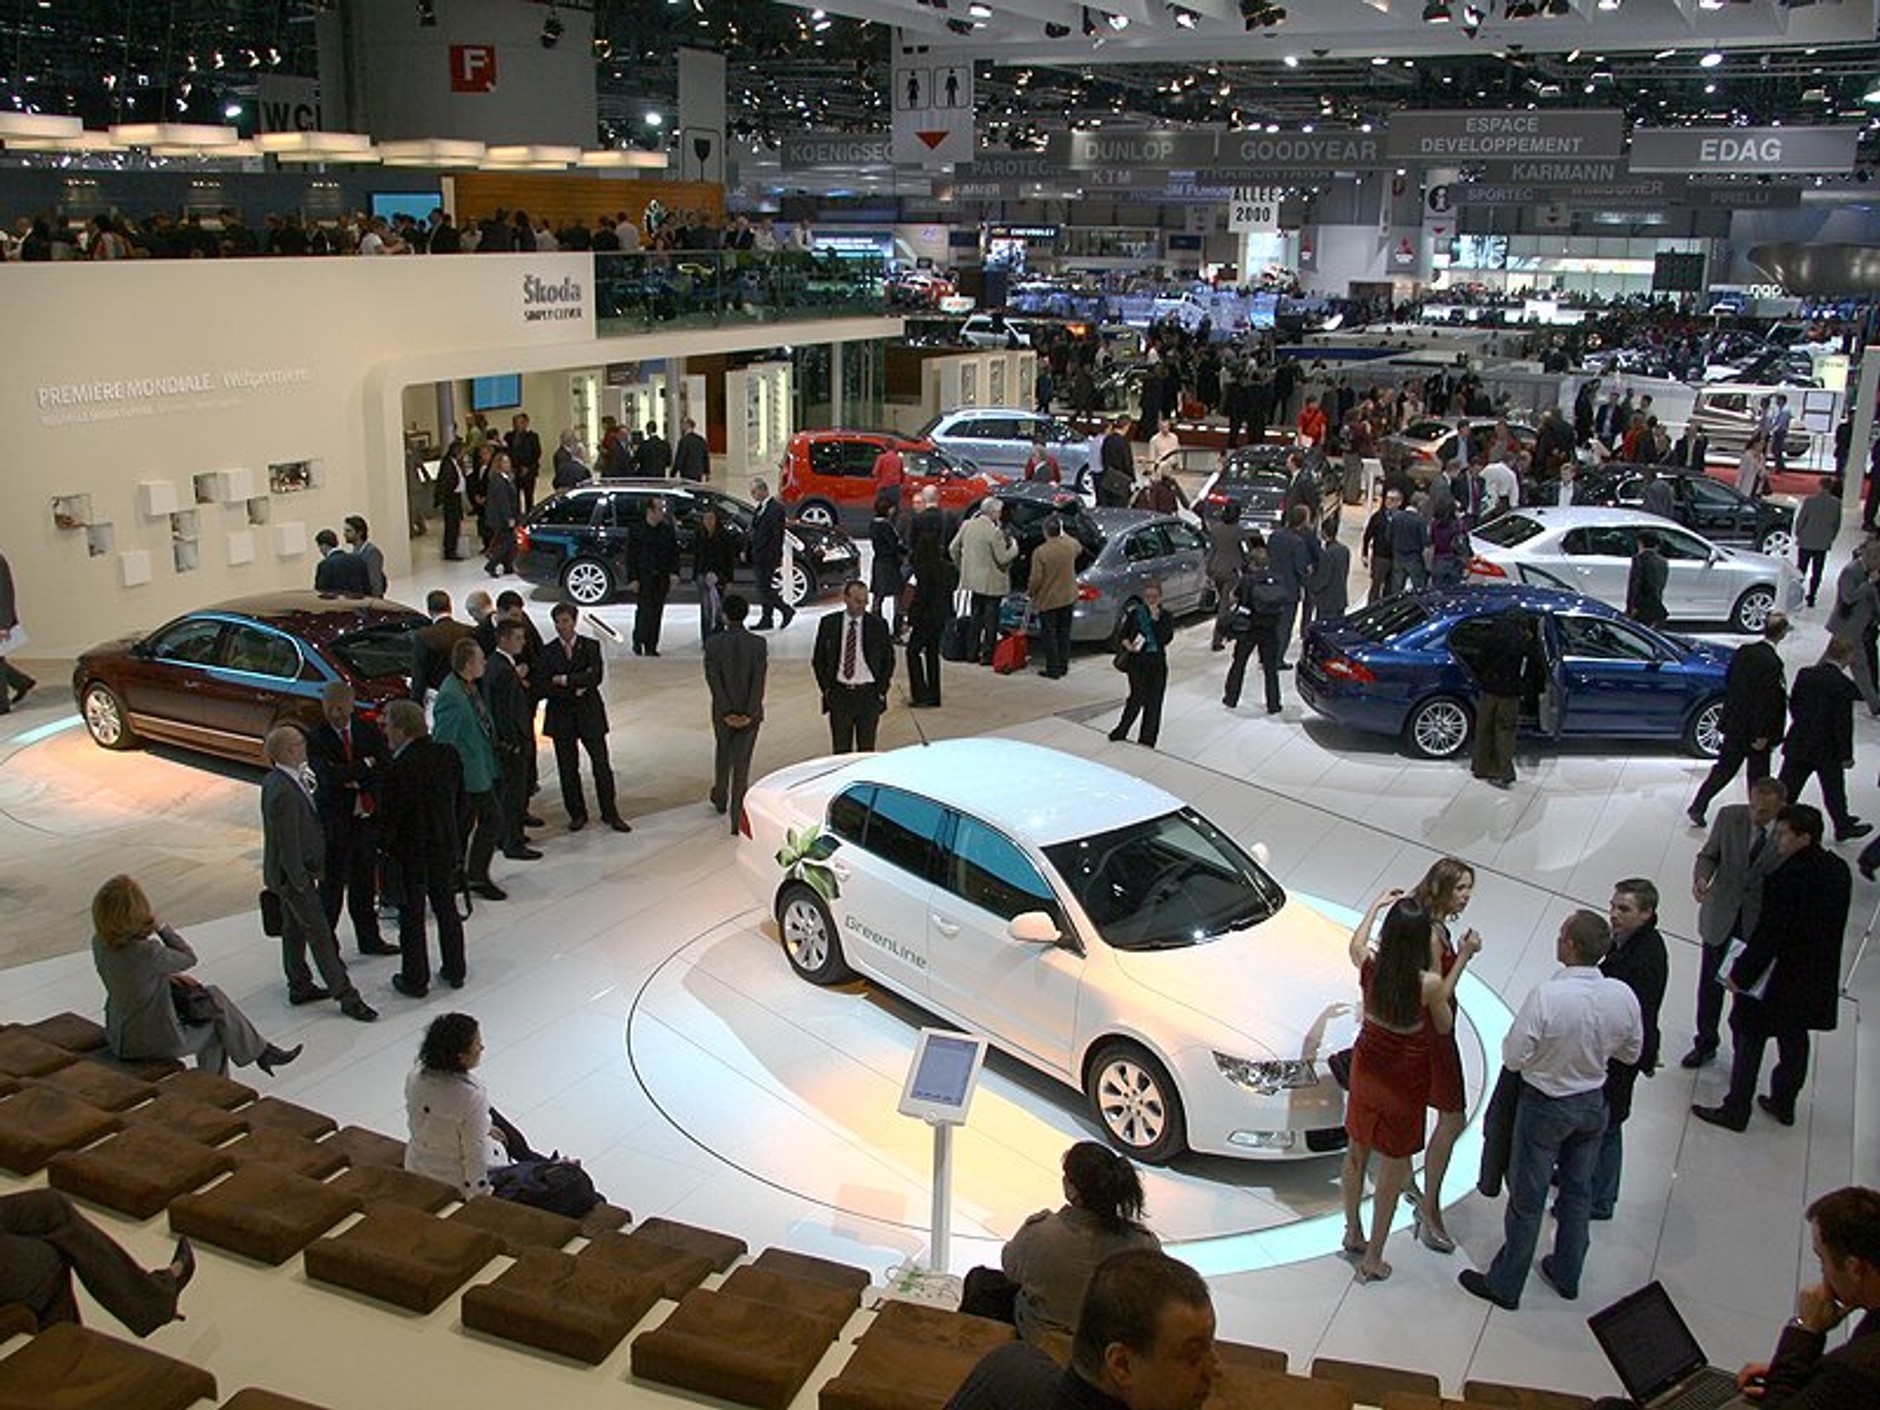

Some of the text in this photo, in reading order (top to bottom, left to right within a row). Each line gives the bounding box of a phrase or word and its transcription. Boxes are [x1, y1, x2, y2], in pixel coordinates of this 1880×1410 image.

[462, 48, 487, 80] F
[1466, 117, 1539, 133] ESPACE
[1084, 140, 1174, 162] DUNLOP
[1240, 141, 1377, 161] GOODYEAR
[1421, 137, 1582, 154] DEVELOPPEMENT
[1700, 138, 1782, 162] EDAG
[1091, 169, 1131, 185] KTM
[1512, 163, 1615, 182] KARMANN
[1468, 187, 1534, 201] SPORTEC
[1236, 206, 1271, 222] 2000
[844, 914, 928, 970] GreenLine
